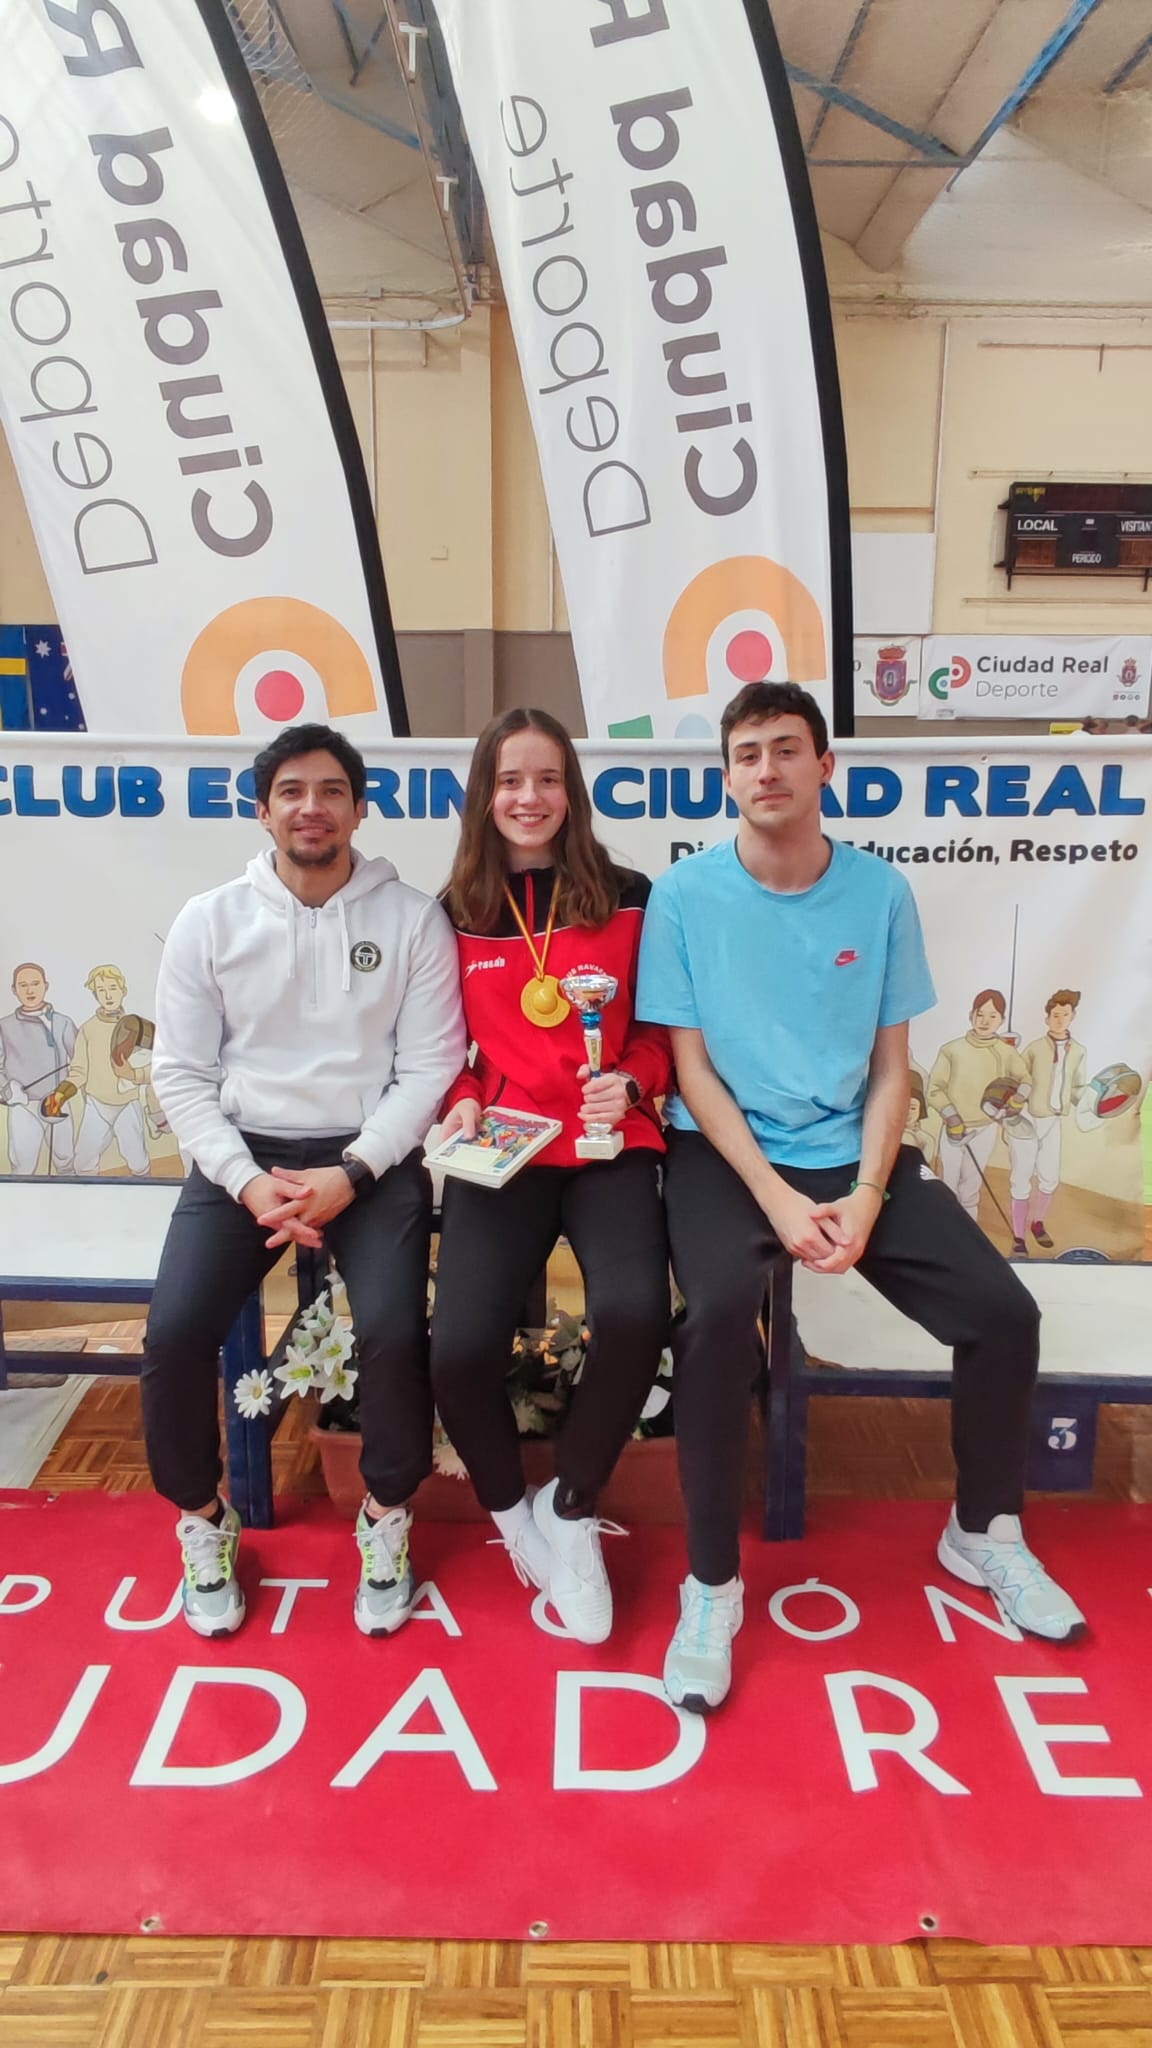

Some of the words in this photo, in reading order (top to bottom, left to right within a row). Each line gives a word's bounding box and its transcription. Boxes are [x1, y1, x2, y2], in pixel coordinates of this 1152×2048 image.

[1017, 519, 1058, 531] LOCAL
[977, 656, 1054, 673] Ciudad
[1063, 657, 1109, 673] Real
[976, 680, 1059, 699] Deporte
[0, 765, 165, 818] LUB
[925, 764, 1146, 817] REAL
[1009, 839, 1138, 864] Respeto
[1048, 1417, 1077, 1450] 3
